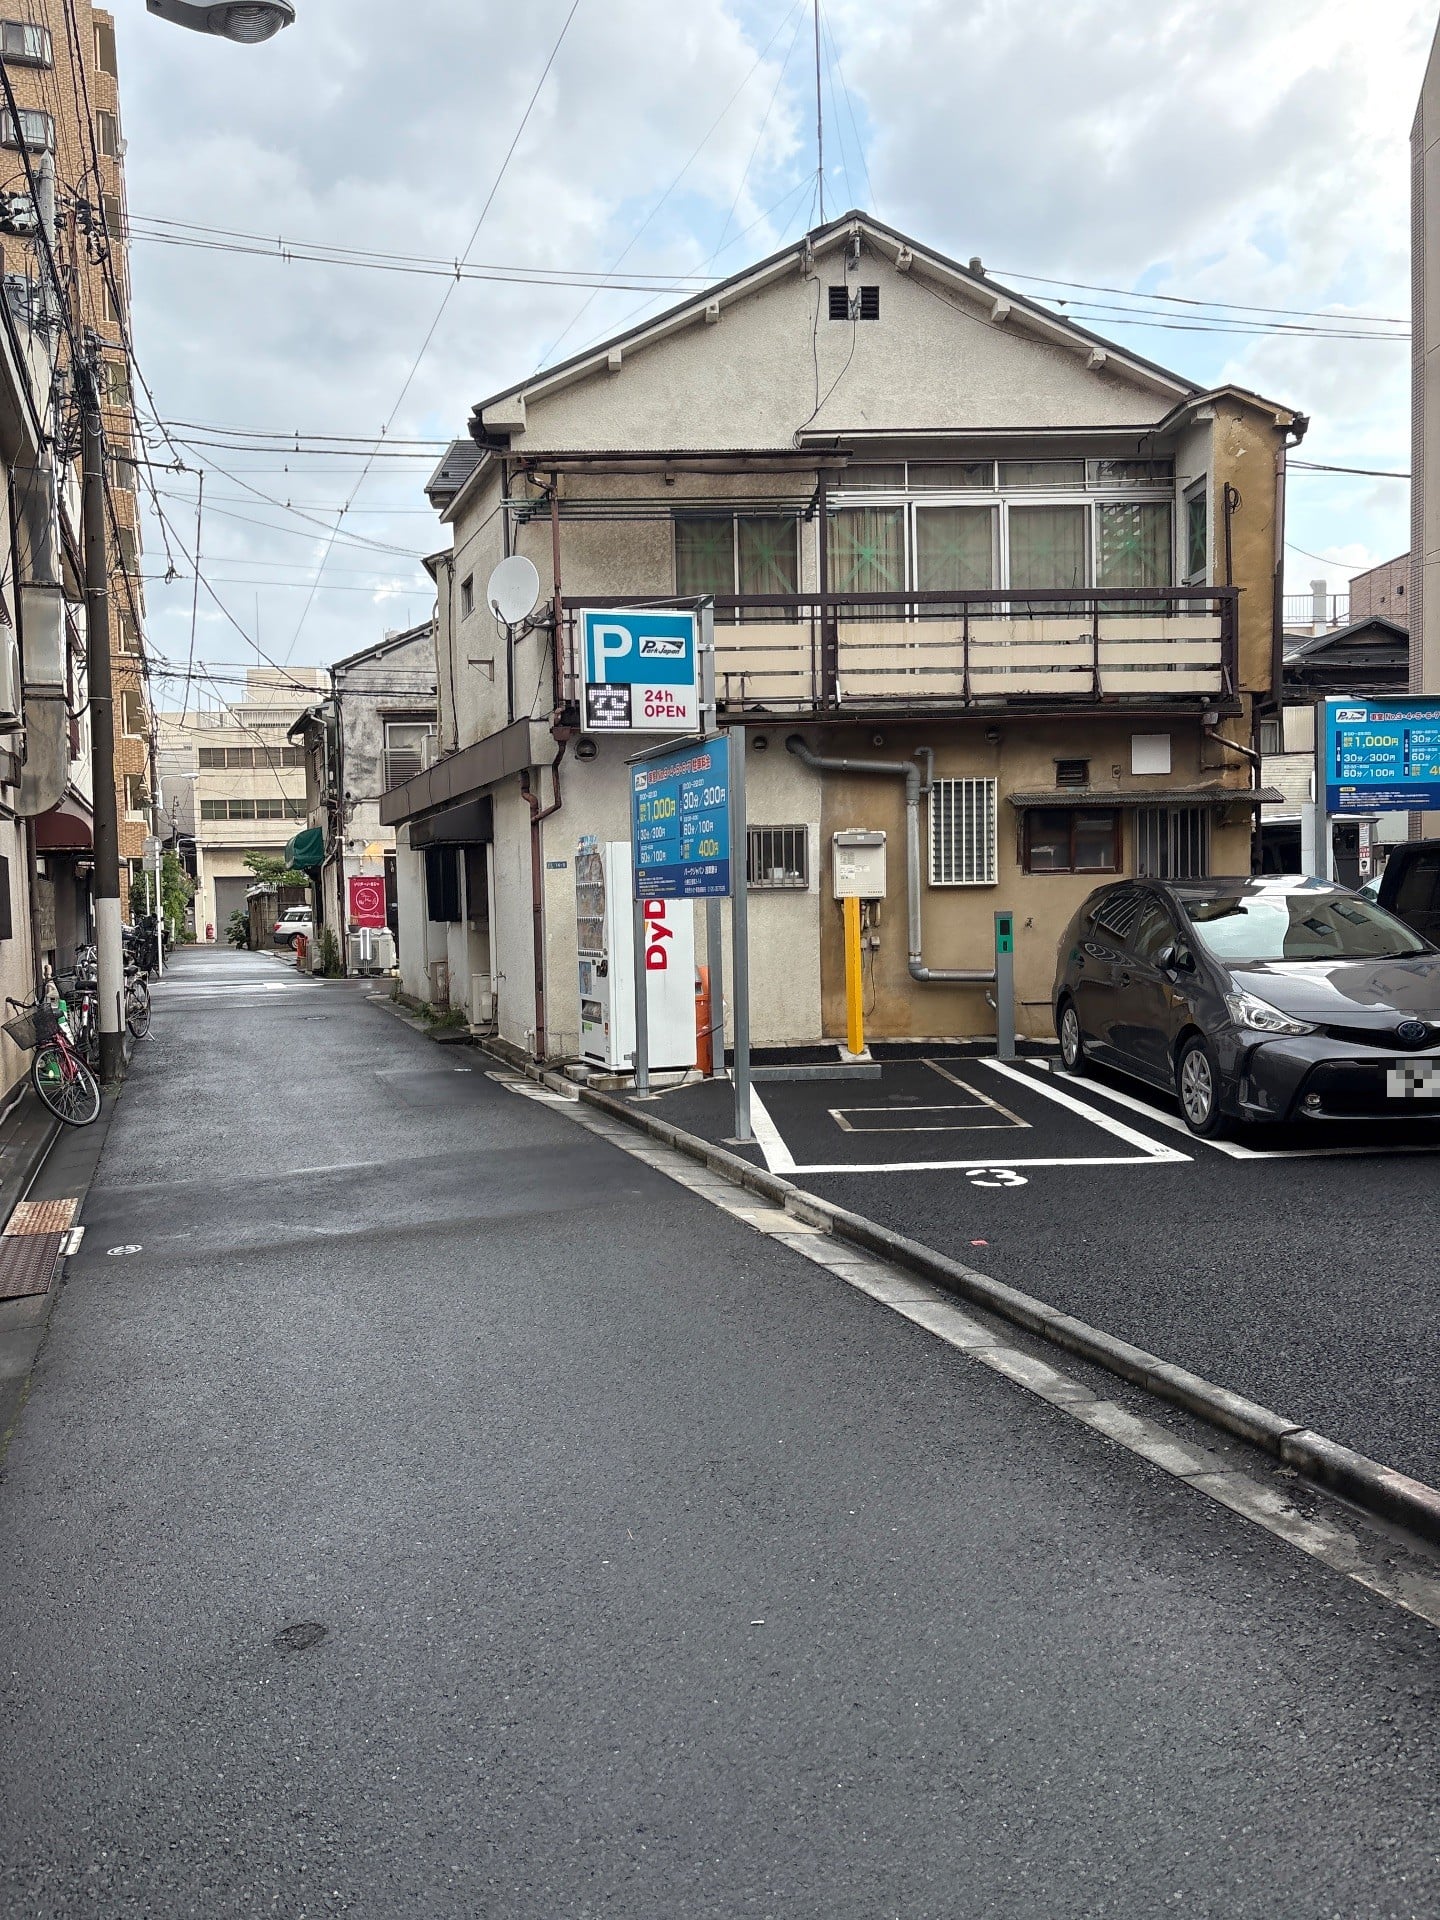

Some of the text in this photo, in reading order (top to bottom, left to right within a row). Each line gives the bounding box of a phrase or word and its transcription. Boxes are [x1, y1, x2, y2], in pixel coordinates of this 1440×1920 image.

[593, 624, 632, 683] P
[641, 640, 680, 655] Park Japan
[644, 690, 673, 702] 24h
[589, 685, 630, 727] 空
[644, 705, 686, 718] OPEN
[1355, 736, 1399, 749] 1,000円
[683, 785, 726, 810] 30分/300円
[647, 797, 676, 821] 1,000円
[641, 827, 666, 840] 30分/300円
[684, 821, 713, 836] 60分/100円
[699, 839, 719, 857] 400円
[966, 1169, 1029, 1187] 3
